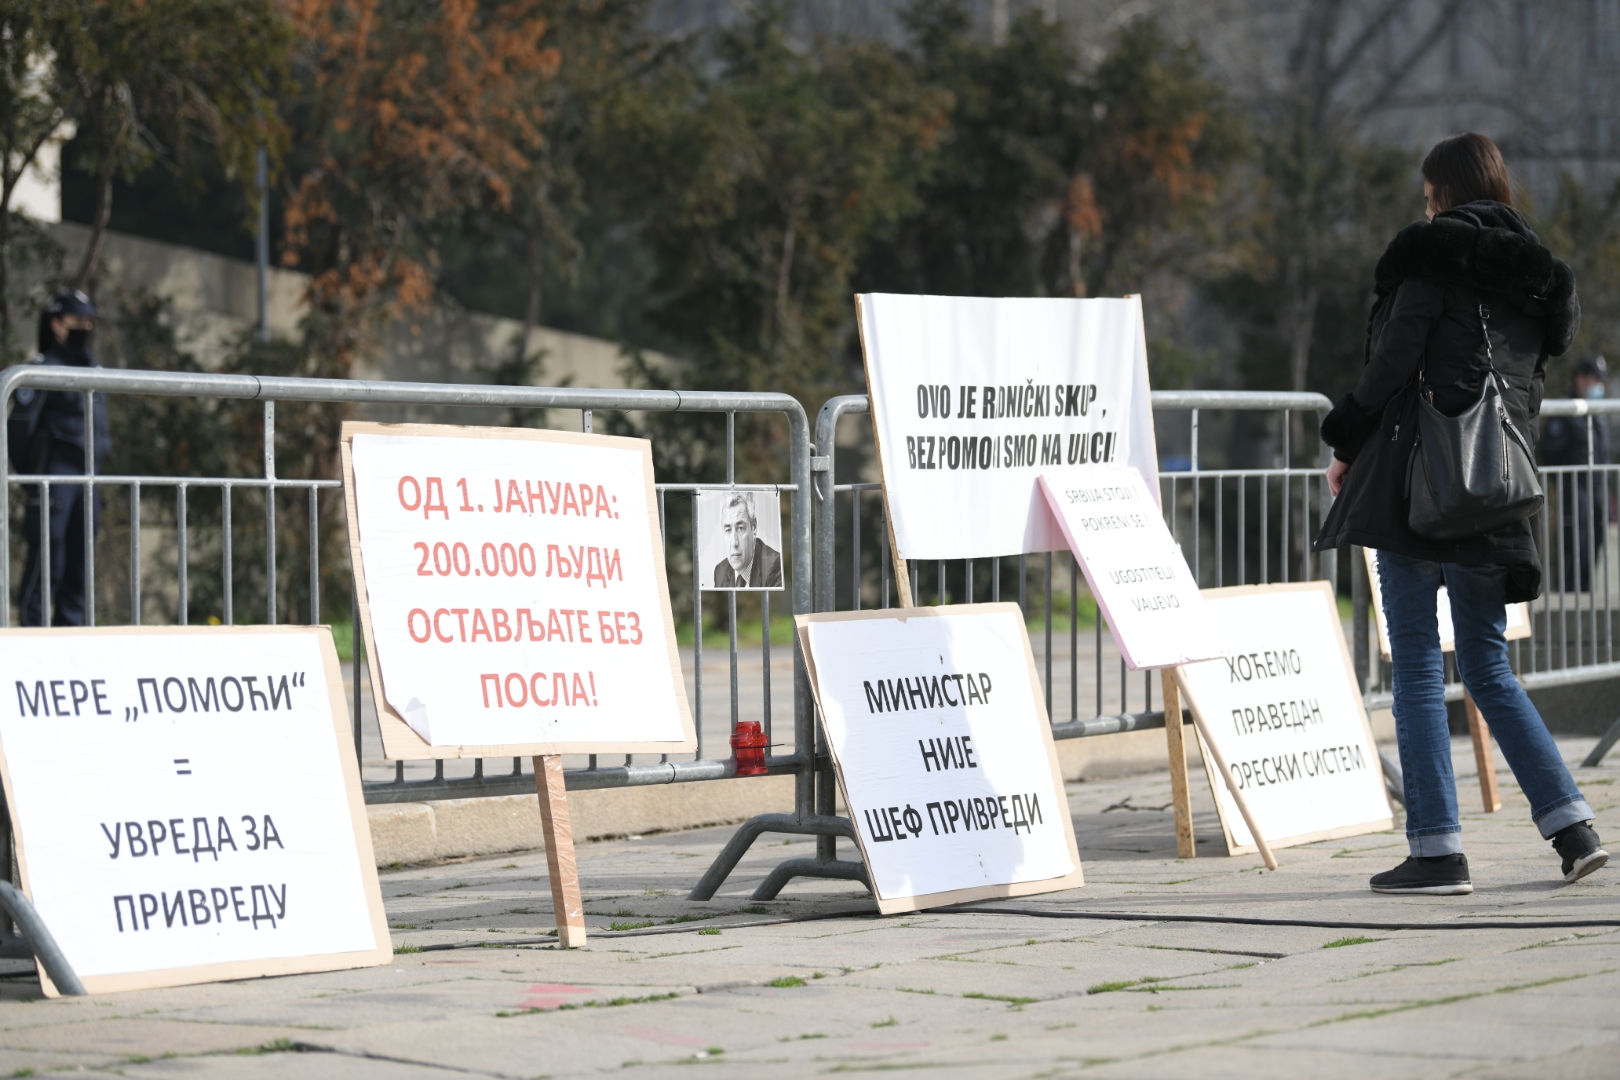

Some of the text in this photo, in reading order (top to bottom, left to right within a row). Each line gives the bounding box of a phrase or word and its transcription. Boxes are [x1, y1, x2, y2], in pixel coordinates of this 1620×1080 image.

[917, 384, 951, 419] OVO
[957, 385, 977, 419] JE
[982, 378, 1050, 419] RDNIČKI
[938, 435, 1000, 470] POMOI
[1004, 433, 1037, 468] SMO
[1040, 433, 1062, 466] NA
[398, 475, 619, 520] ОД 1. ЈАНУАРА:
[1065, 488, 1104, 504] SRBIJA
[1081, 515, 1130, 531] POKRENI
[1130, 513, 1145, 528] SE
[413, 541, 623, 588] 200.000 ЉУДИ
[1109, 565, 1176, 585] UGOSTITELJI
[1131, 594, 1180, 612] VALJEVO
[407, 608, 643, 645] ОСТАВЉАТЕ БЕЗ
[1225, 649, 1301, 683] ХОЋЕМО
[15, 679, 112, 717] МЕРЕ
[480, 671, 599, 708] ПОСЛА!
[863, 672, 992, 713] МИНИСТАР
[1232, 698, 1324, 735] ПРАВЕДАН
[918, 736, 977, 772] НИЈЕ
[1227, 744, 1366, 790] ОРЕСКИ СИСТЕМ
[864, 793, 1043, 842] ШЕФ ПРИВРЕДИ
[100, 814, 284, 863] УВРЕДА ЗА
[113, 883, 287, 932] ПРИВРЕДУ
